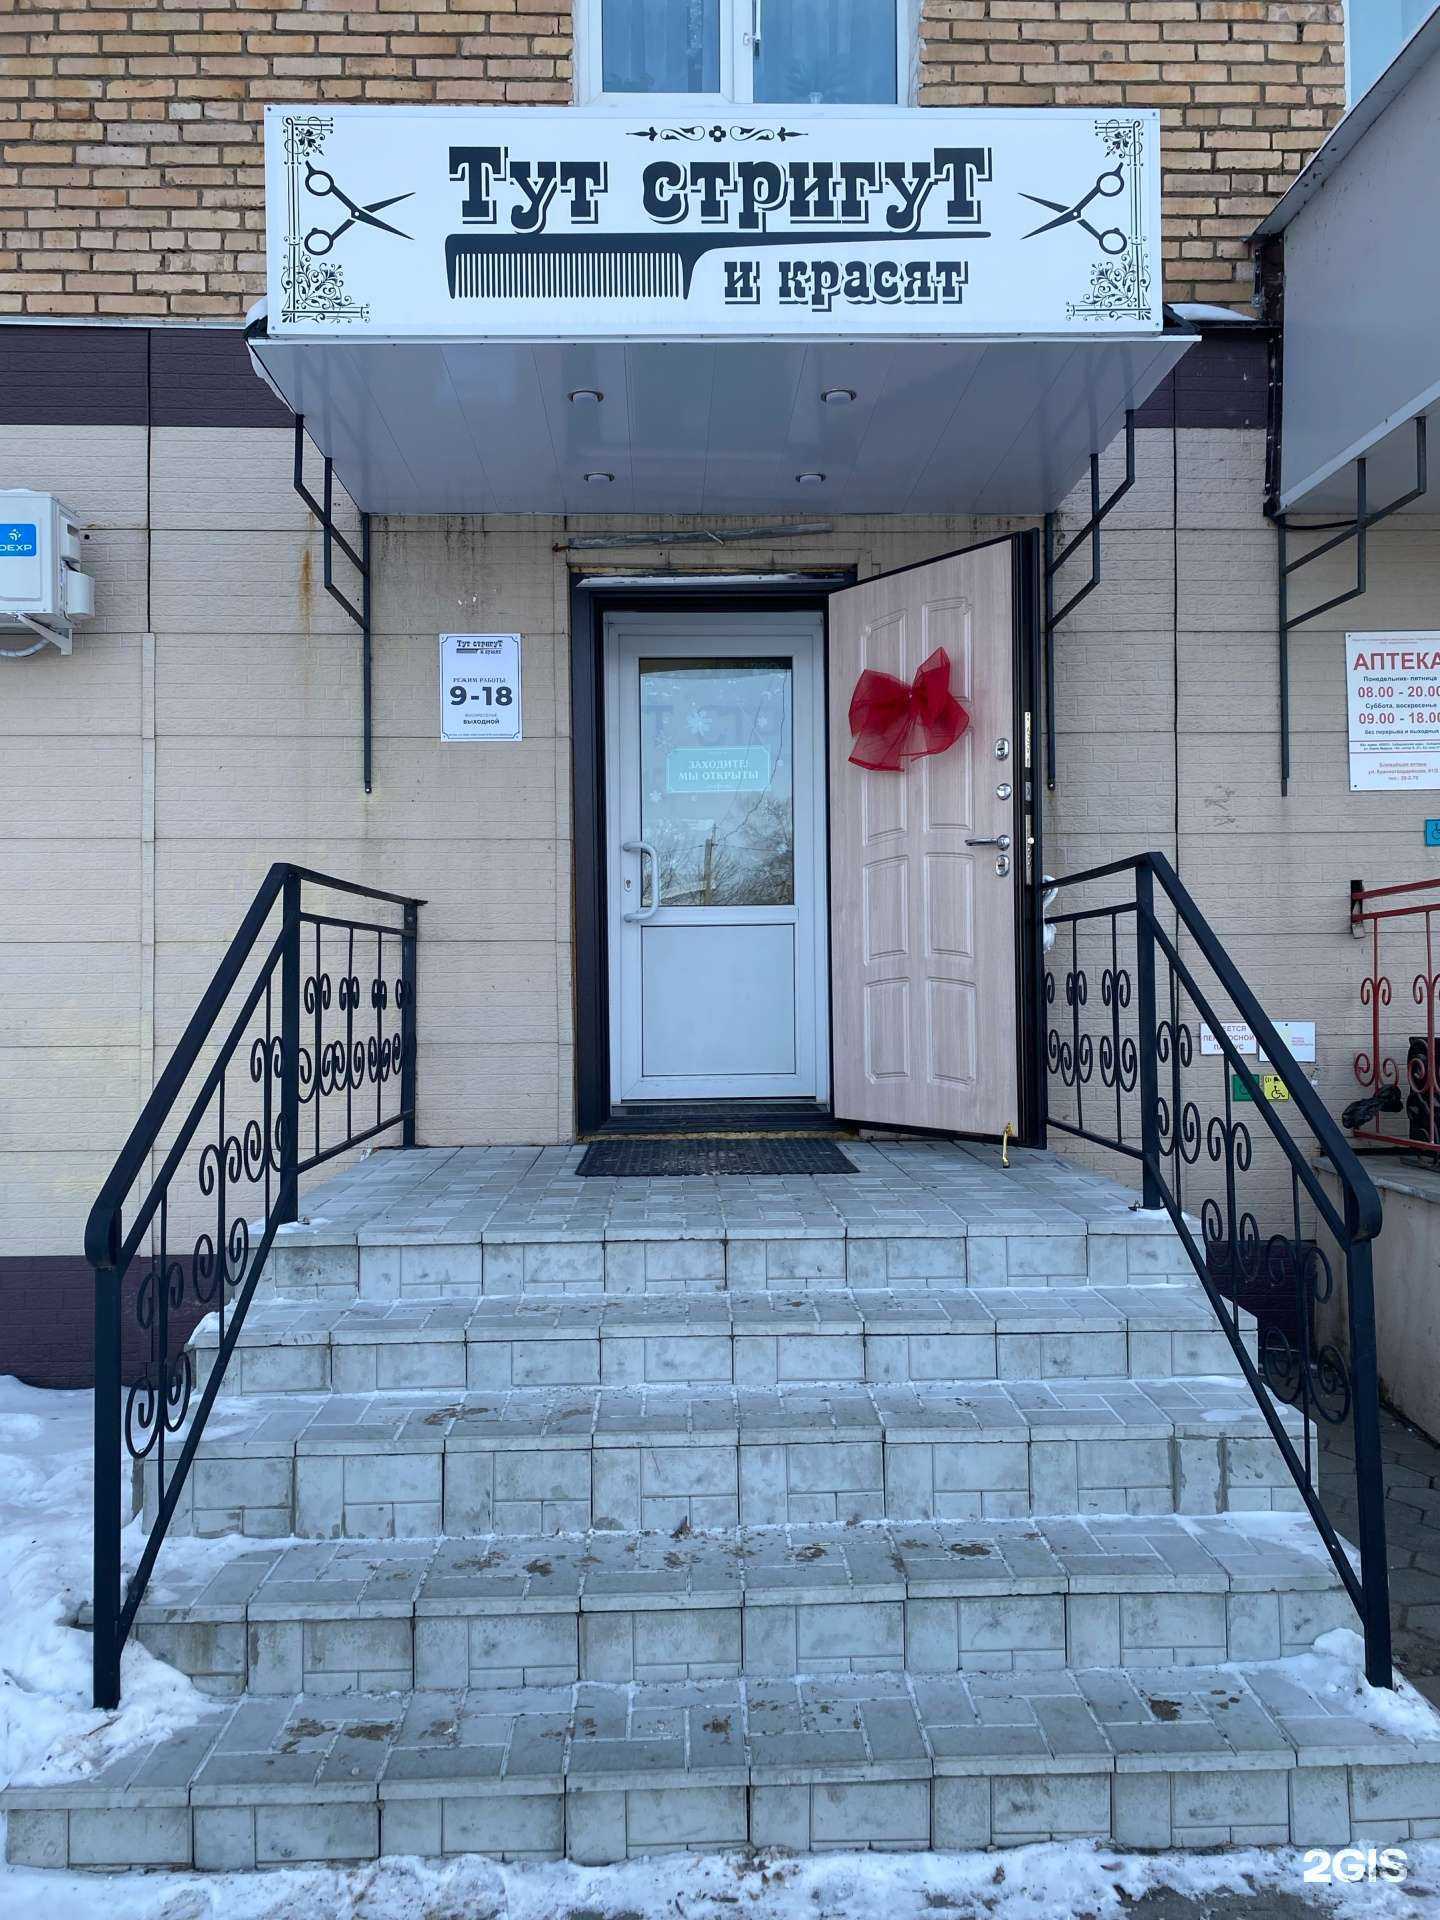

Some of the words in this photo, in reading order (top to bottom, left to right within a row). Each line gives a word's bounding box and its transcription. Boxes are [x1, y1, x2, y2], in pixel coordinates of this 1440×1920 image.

[448, 146, 608, 234] Тут
[723, 260, 761, 304] и
[777, 259, 969, 312] красят
[1353, 651, 1440, 671] АПТЕКА
[1357, 686, 1394, 698] 08.00
[1358, 712, 1395, 724] 09.00
[679, 771, 698, 781] МЫ
[702, 770, 759, 781] ОТКРЫТЫ
